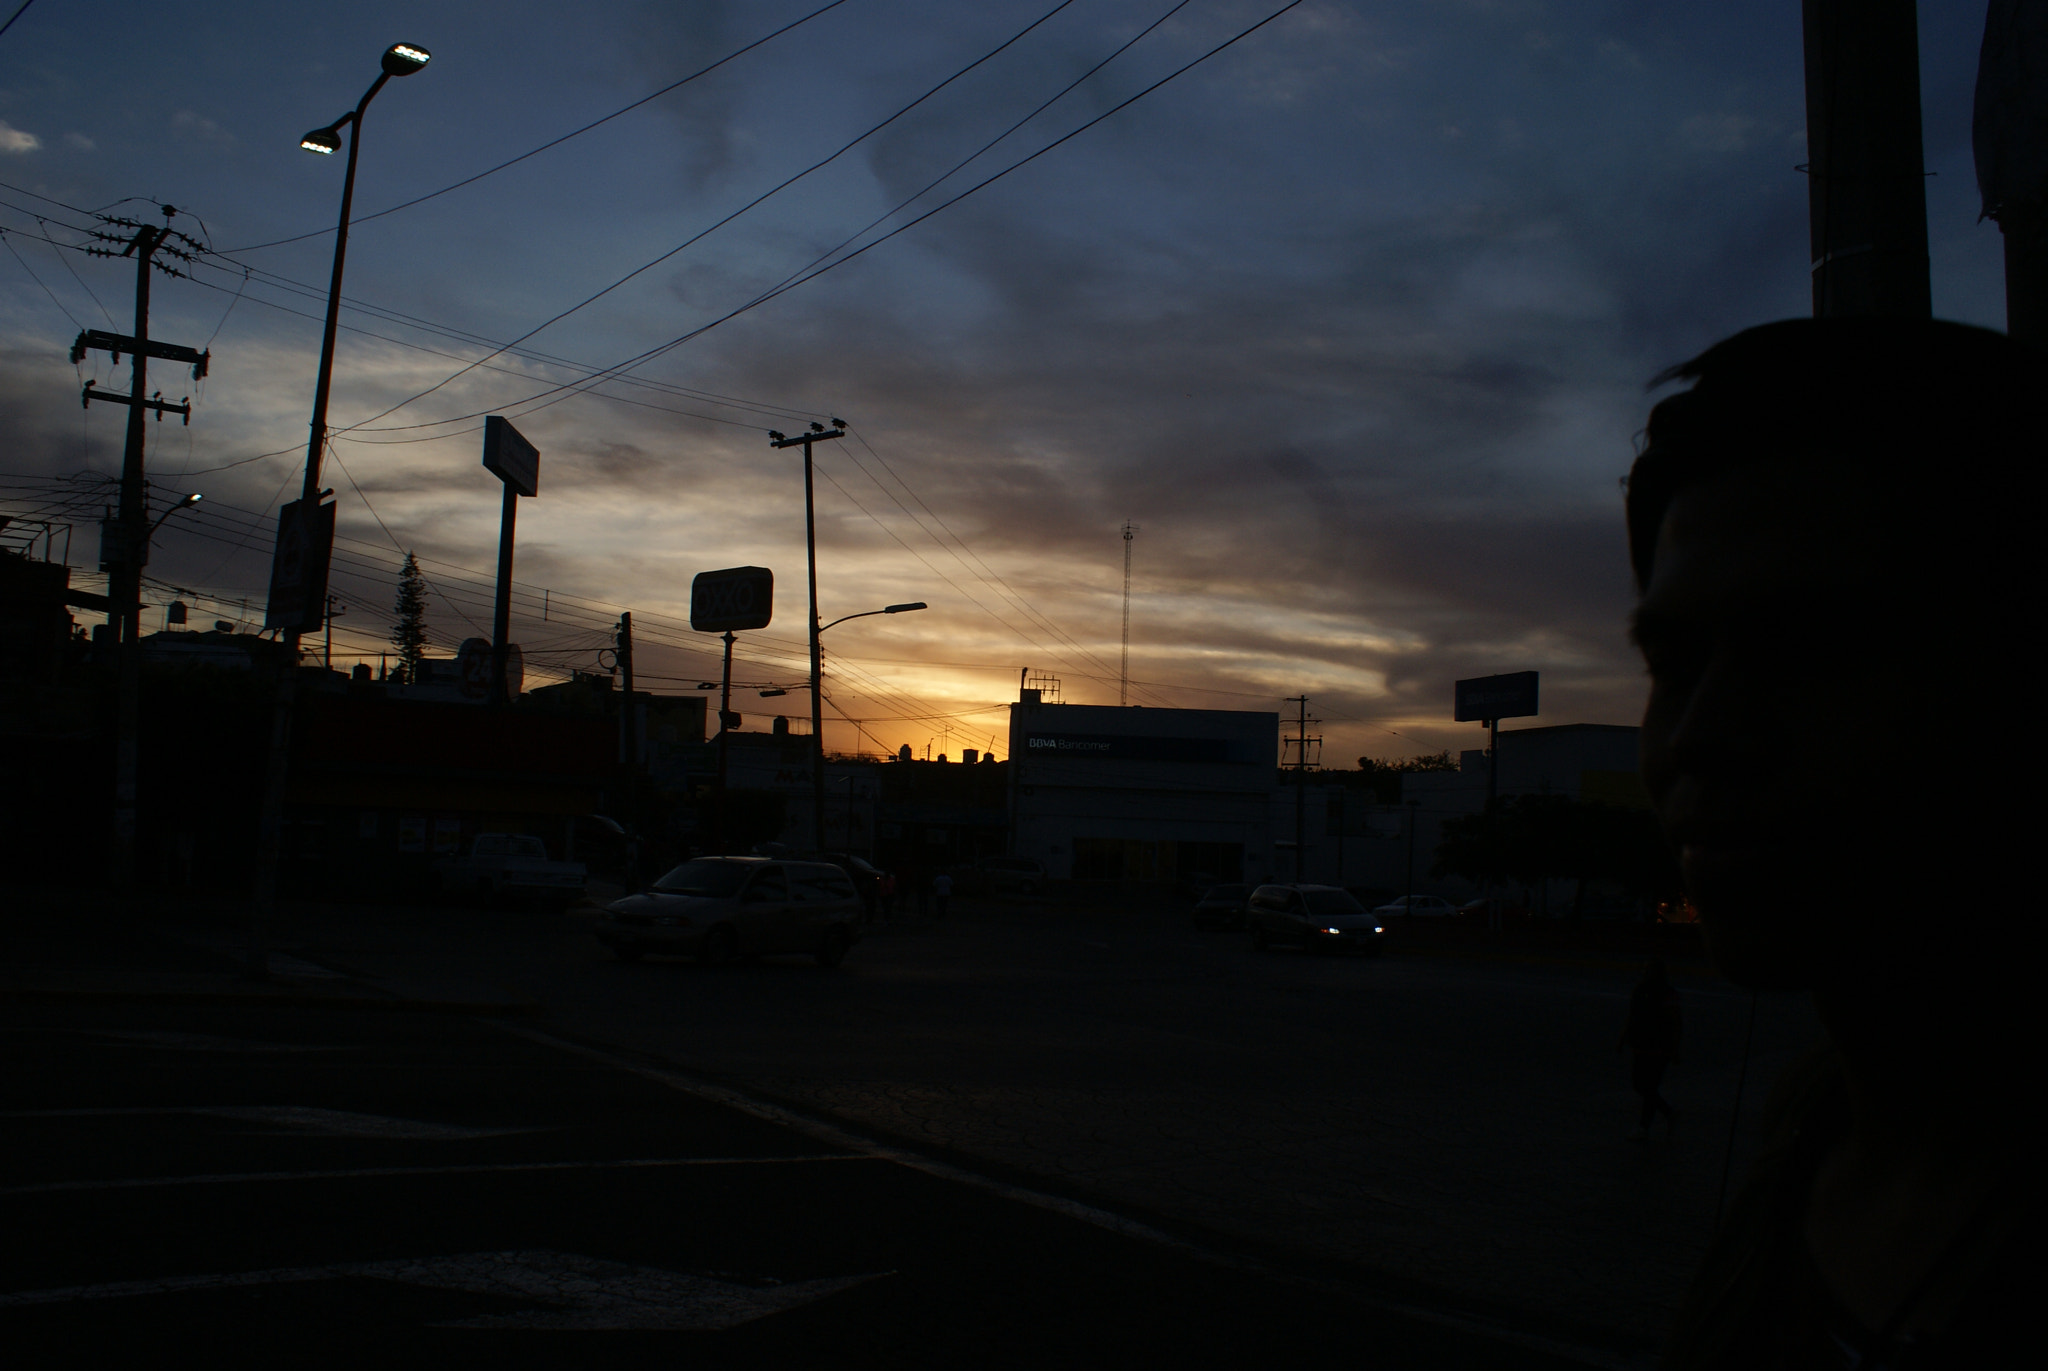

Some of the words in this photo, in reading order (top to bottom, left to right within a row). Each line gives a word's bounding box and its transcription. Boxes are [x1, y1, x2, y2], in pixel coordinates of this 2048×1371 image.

[695, 578, 754, 619] OXXO
[1029, 737, 1057, 749] BBVA
[1058, 738, 1112, 751] Bancomer
